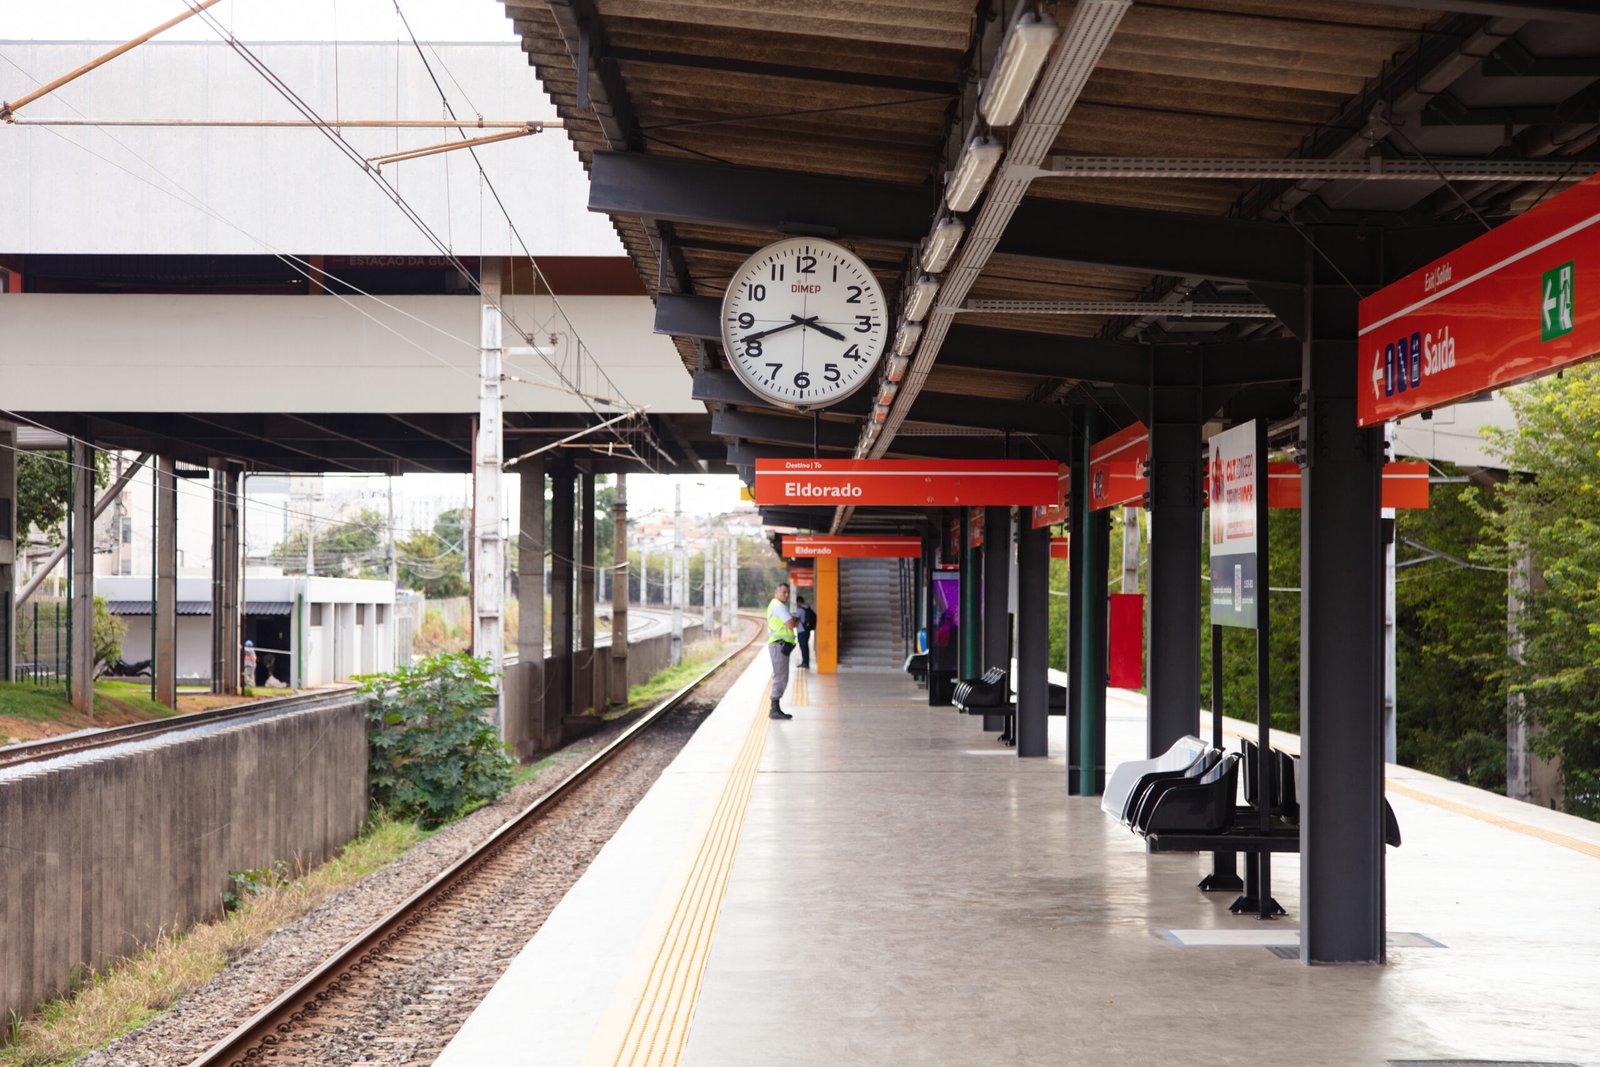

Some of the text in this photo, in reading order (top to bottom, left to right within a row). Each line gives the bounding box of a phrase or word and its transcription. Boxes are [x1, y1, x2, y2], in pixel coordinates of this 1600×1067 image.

[771, 263, 785, 281] 11
[796, 256, 817, 274] 12
[832, 265, 838, 283] 1
[748, 284, 766, 302] 10
[791, 284, 821, 294] DIMEP
[846, 286, 862, 304] 2
[737, 312, 755, 330] 9
[854, 315, 872, 333] 3
[744, 339, 763, 358] 8
[843, 344, 861, 362] 4
[1424, 326, 1456, 376] Saída
[765, 363, 783, 381] 7
[793, 372, 811, 389] 6
[823, 363, 841, 382] 5
[785, 482, 862, 497] Eldorado
[795, 546, 832, 555] Eldorado
